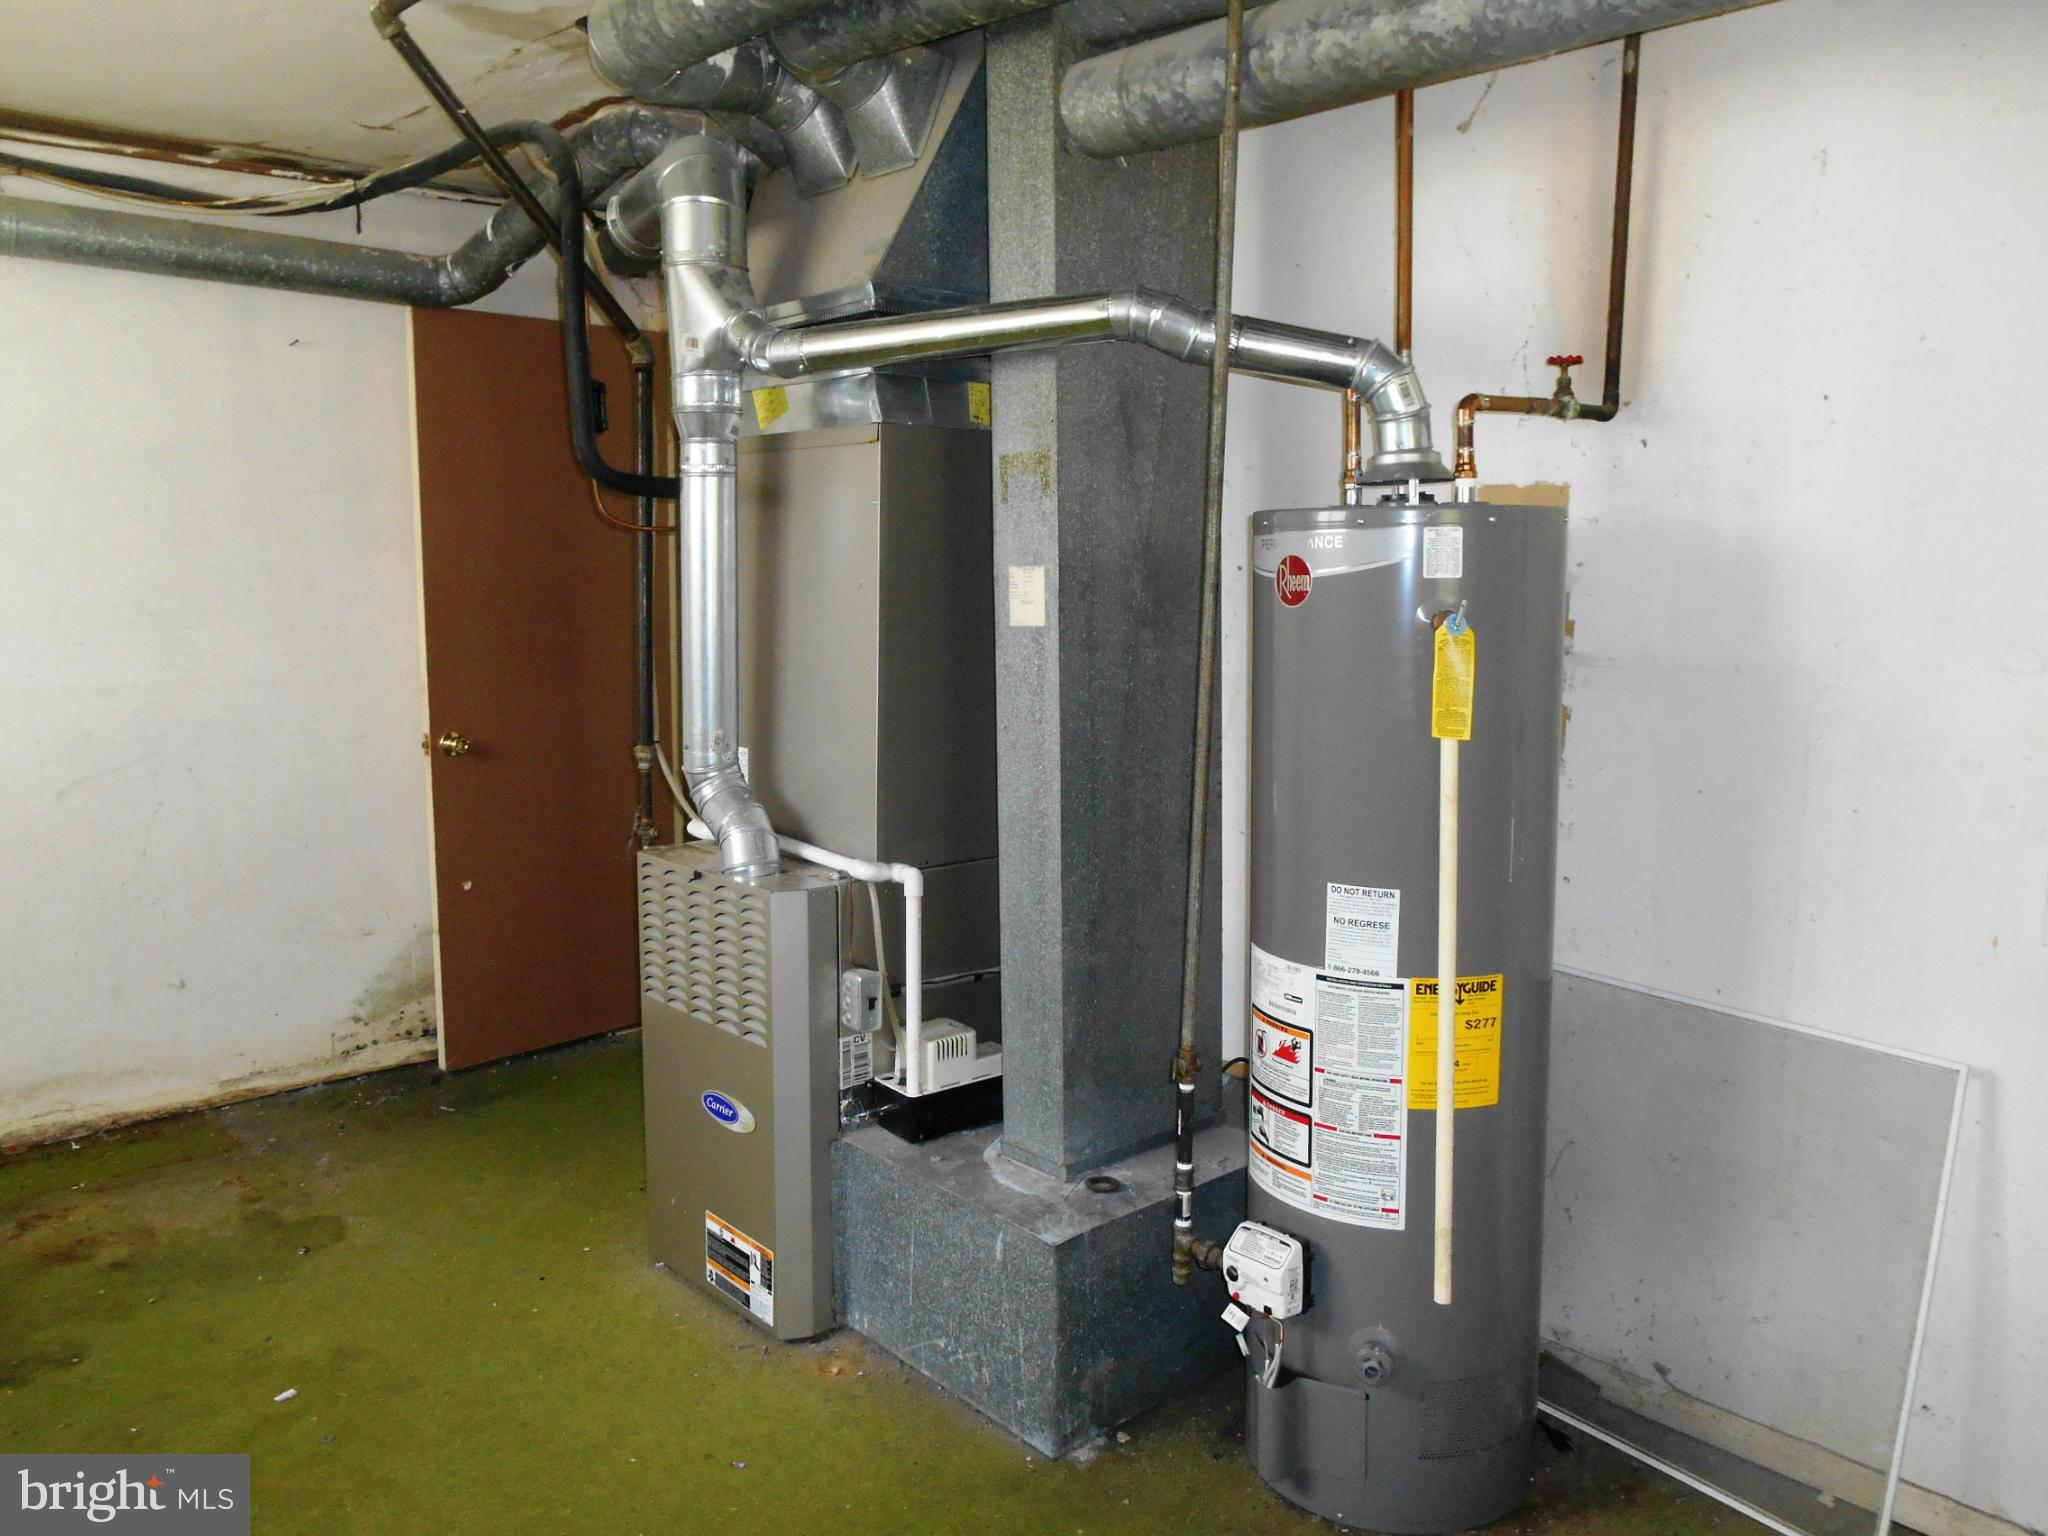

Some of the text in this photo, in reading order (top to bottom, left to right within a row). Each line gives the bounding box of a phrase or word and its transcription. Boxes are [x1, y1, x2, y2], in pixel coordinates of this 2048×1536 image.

[1279, 556, 1310, 599] Rheem
[1331, 885, 1395, 899] DO NOT RETURN
[1333, 916, 1391, 930] NO REGRESE
[706, 1096, 733, 1117] Carrier
